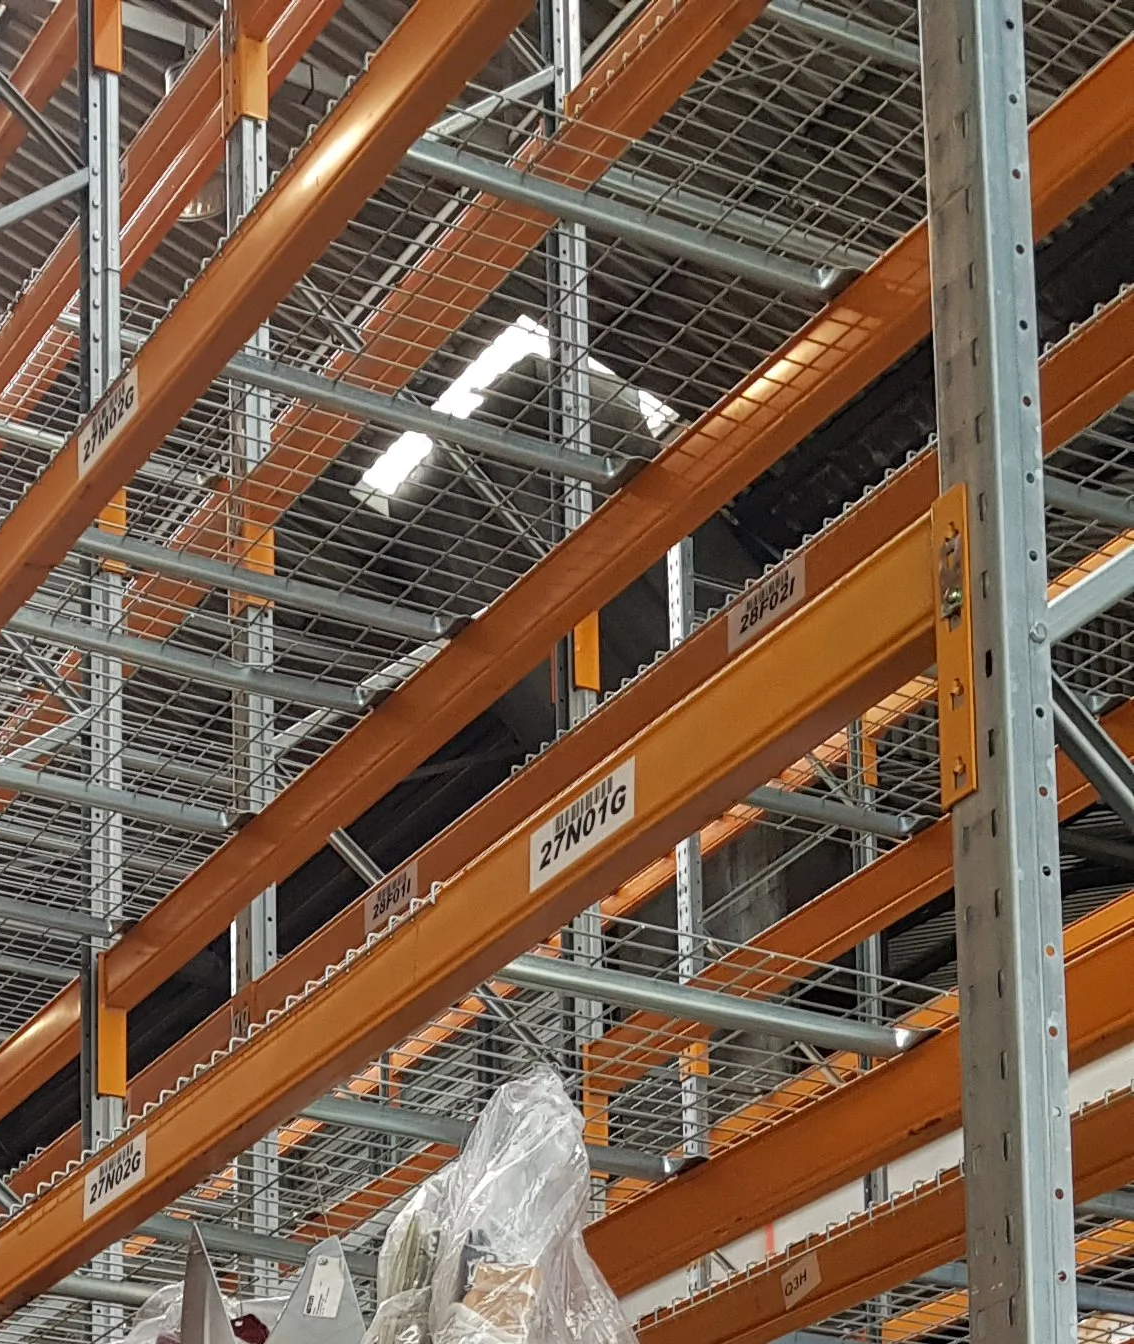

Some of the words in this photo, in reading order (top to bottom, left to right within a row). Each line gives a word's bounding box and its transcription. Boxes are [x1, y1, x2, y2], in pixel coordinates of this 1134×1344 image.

[83, 385, 134, 463] 27M02G
[538, 784, 626, 871] 27N01G
[89, 1150, 141, 1204] 27N02G
